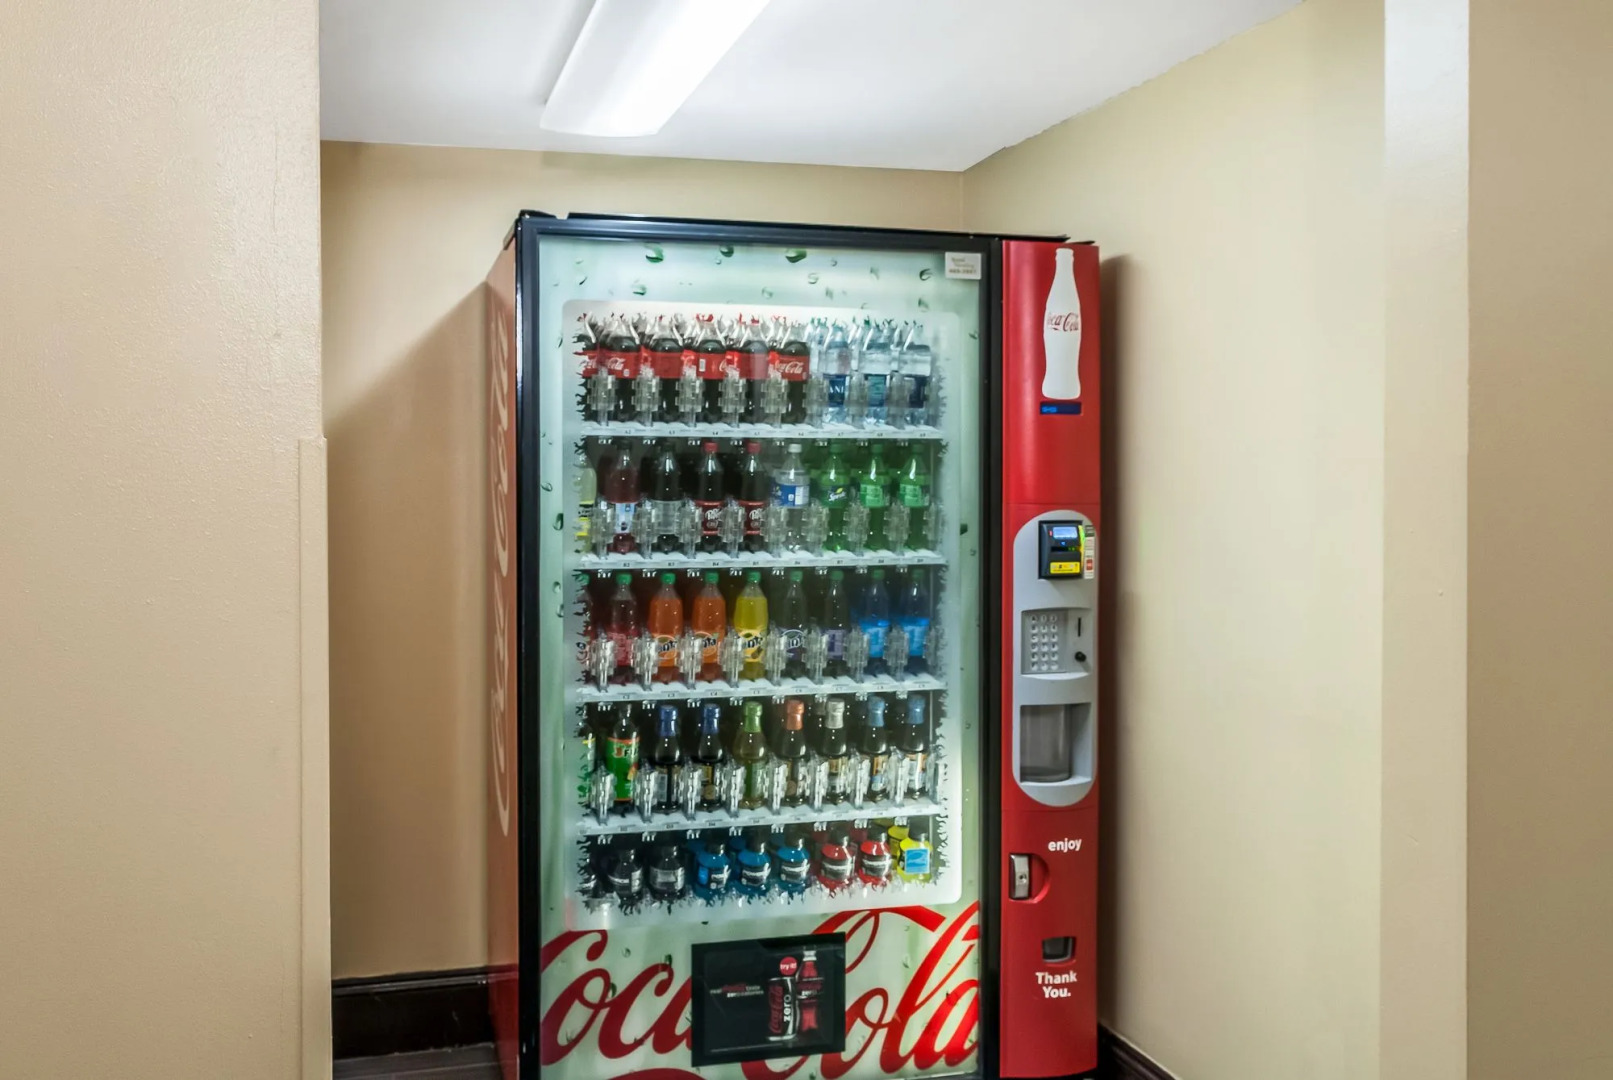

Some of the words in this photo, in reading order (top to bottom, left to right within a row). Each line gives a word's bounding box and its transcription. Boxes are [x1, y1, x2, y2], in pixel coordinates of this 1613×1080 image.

[1048, 838, 1082, 852] enjoy
[1035, 971, 1078, 986] Thank
[1042, 986, 1072, 999] You.
[783, 994, 792, 1022] zero
